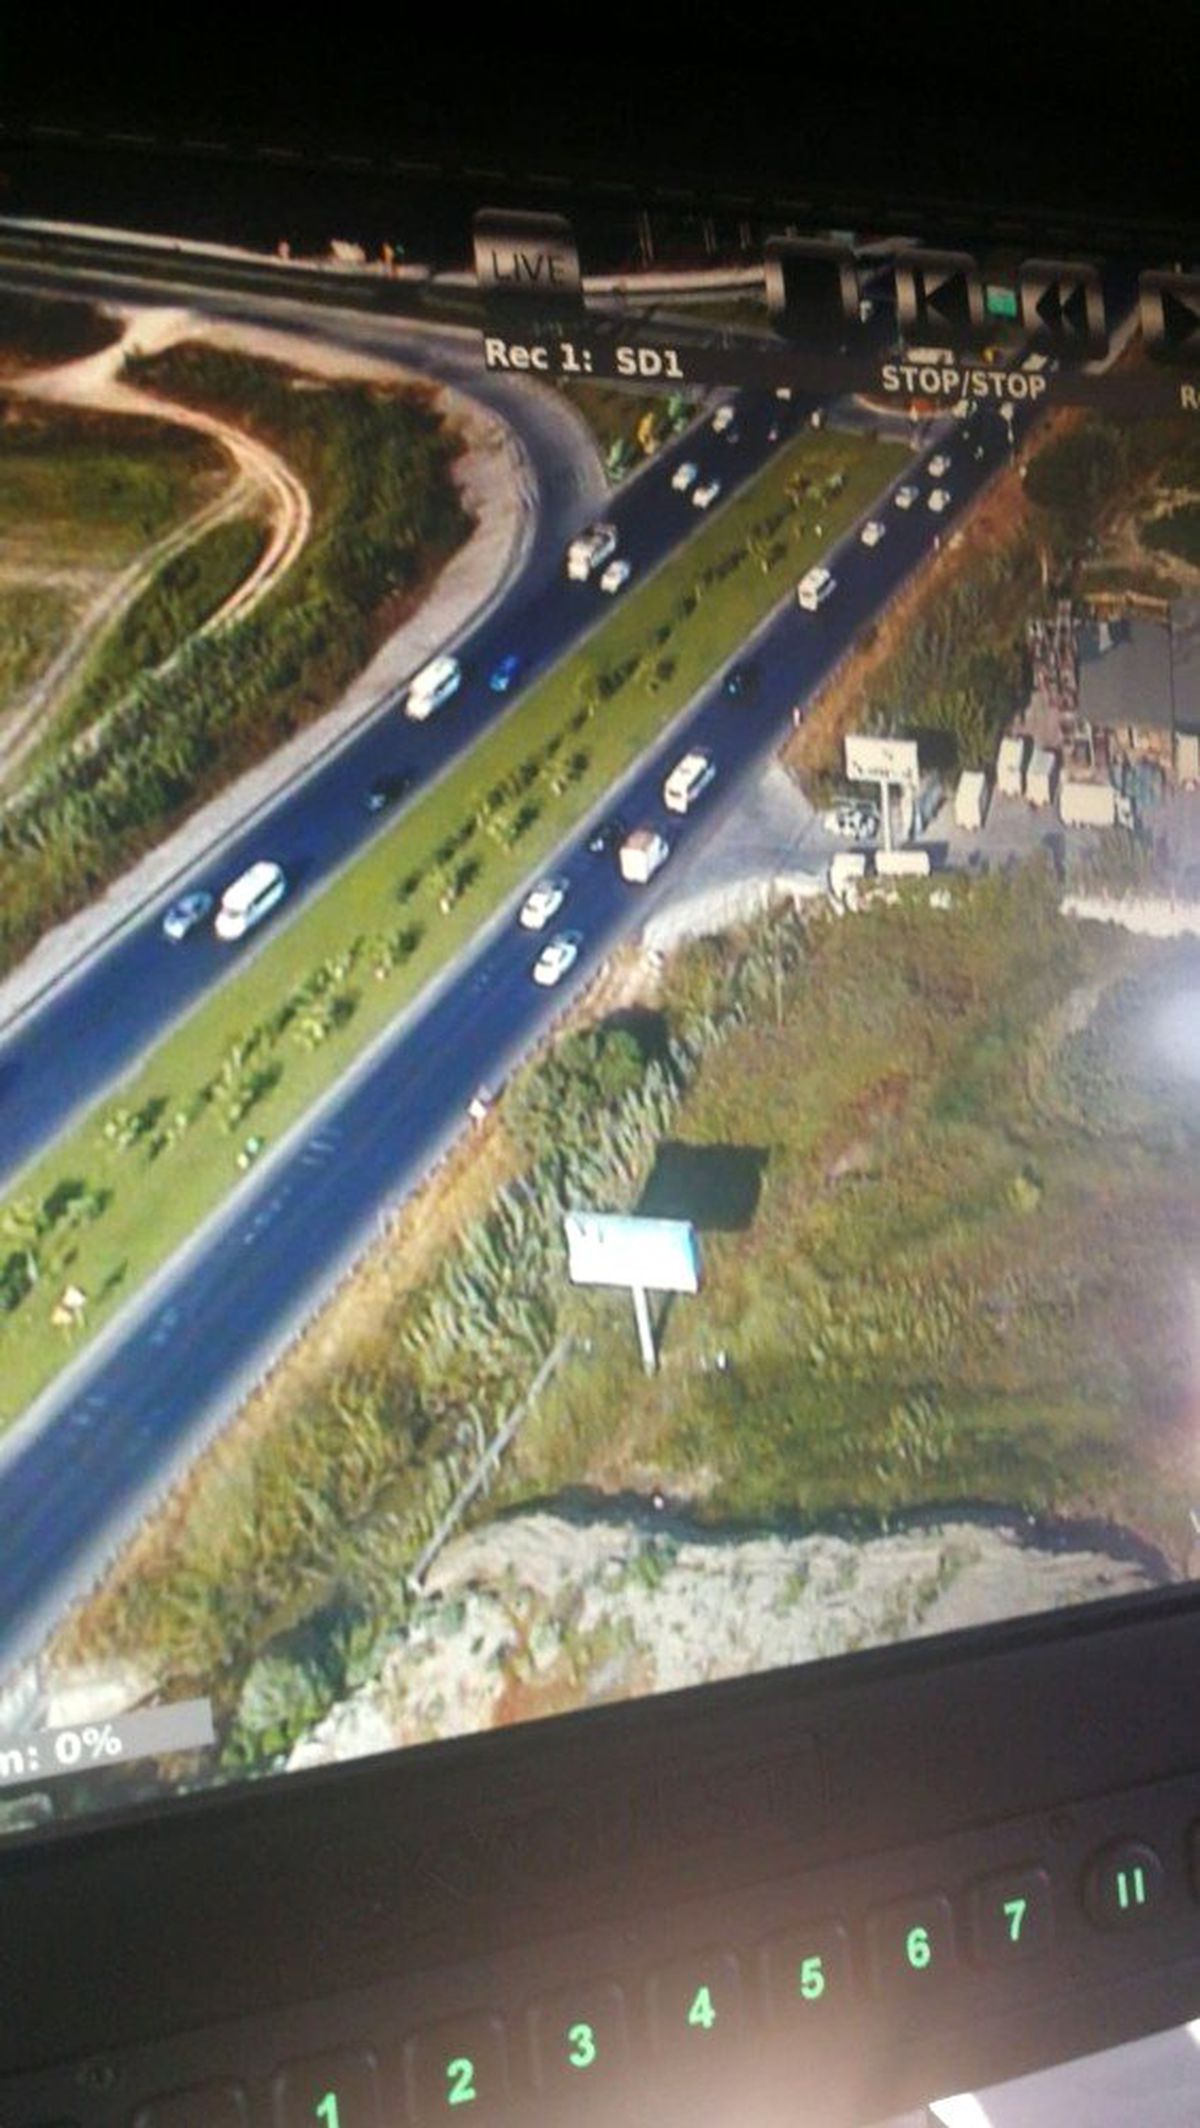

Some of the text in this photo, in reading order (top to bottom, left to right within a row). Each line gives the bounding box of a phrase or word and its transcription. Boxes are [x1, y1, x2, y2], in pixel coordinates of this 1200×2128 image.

[492, 249, 568, 286] LIVE
[484, 336, 684, 379] Rec 1: SD1
[881, 364, 1047, 400] STOP/STOP
[1180, 384, 1200, 410] R
[55, 1723, 122, 1765] 0%
[1003, 1899, 1027, 1940] 7
[905, 1927, 931, 1968] 6
[800, 1957, 824, 1999] 5
[687, 1986, 715, 2028] 4
[568, 2023, 597, 2067] 3
[446, 2057, 476, 2104] 2
[316, 2092, 340, 2128] 1
